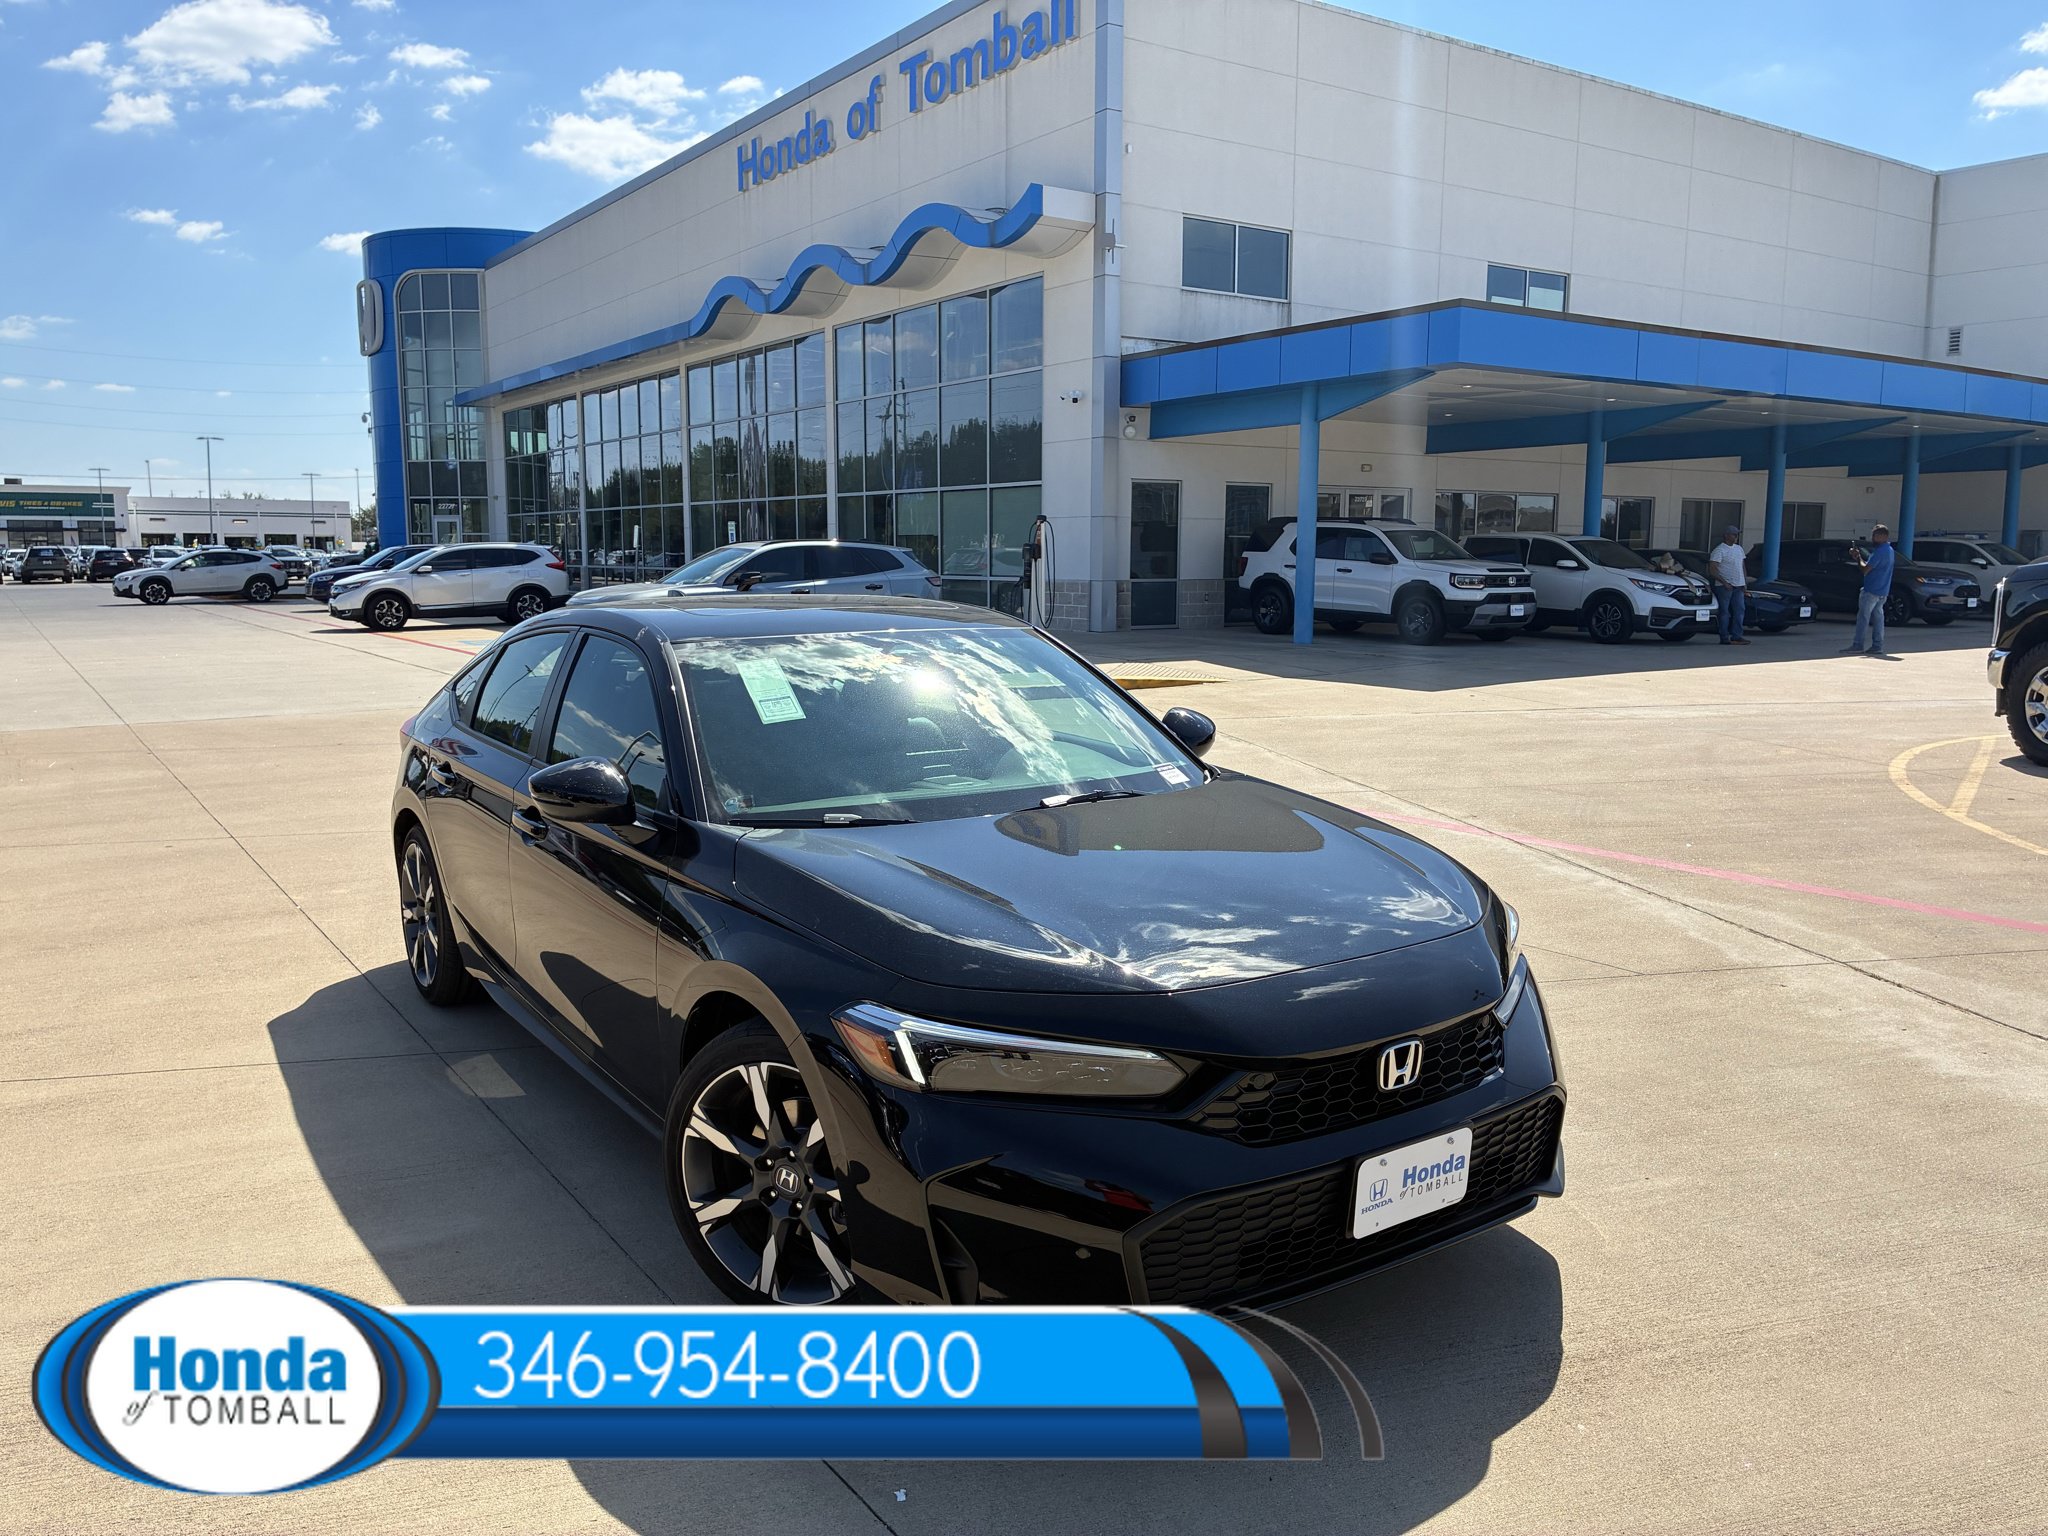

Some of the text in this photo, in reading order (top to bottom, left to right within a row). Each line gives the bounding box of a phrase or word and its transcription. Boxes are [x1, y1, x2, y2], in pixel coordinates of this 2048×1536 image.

[737, 0, 1076, 193] Honda of Tomball
[1399, 1172, 1463, 1200] of TOMBALL
[1402, 1153, 1466, 1188] Honda
[1361, 1197, 1393, 1215] HONDA
